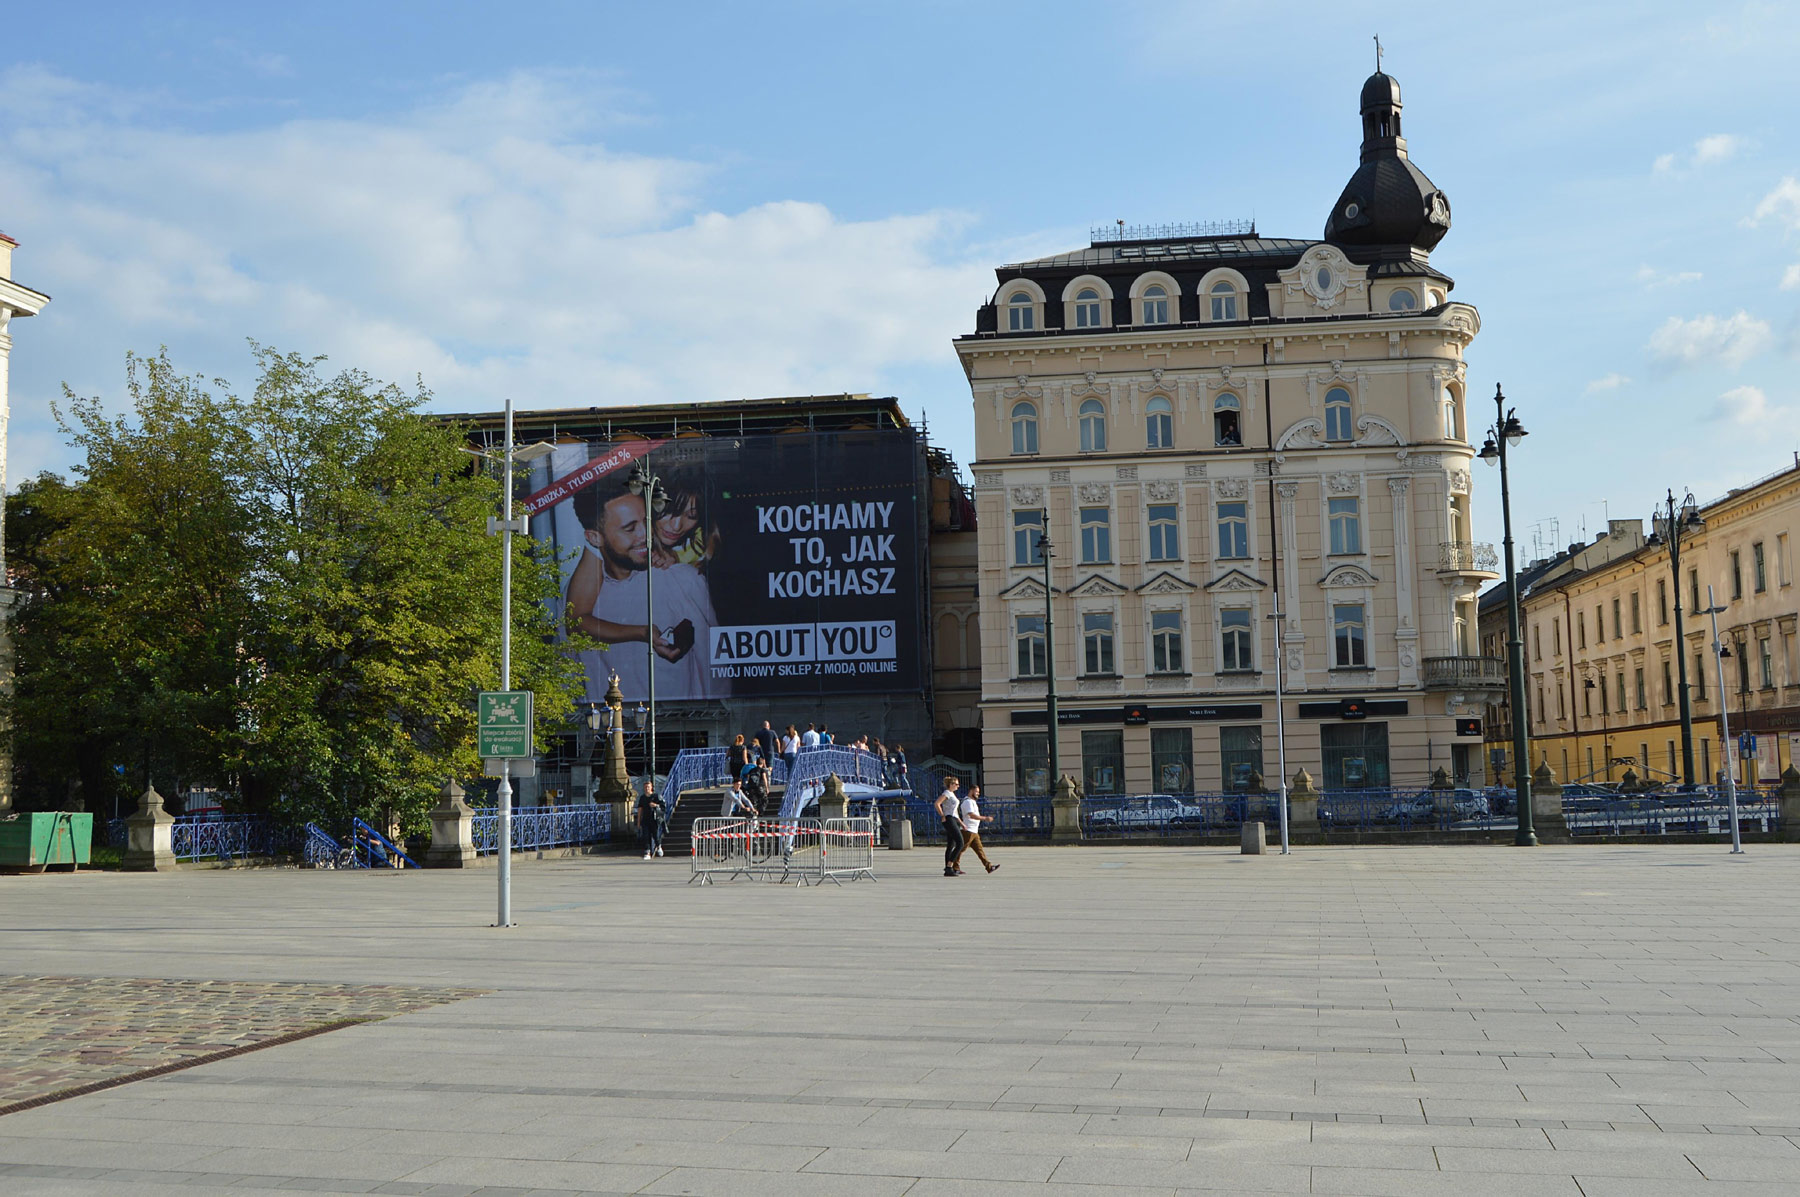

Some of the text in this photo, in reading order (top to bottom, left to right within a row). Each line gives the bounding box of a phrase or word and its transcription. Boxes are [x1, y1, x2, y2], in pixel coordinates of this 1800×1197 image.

[536, 486, 568, 508] ZNIŻKA.
[567, 470, 594, 490] TYLKO
[592, 455, 620, 476] TERAZ
[618, 448, 631, 461] %
[758, 501, 894, 533] KOCHAMY
[789, 534, 896, 569] TO, JAK
[768, 567, 896, 598] KOCHASZ
[714, 629, 811, 660] ABOUT
[710, 661, 897, 679] TWÓJ NOWY SKLEP Z MODĄ ONLINE
